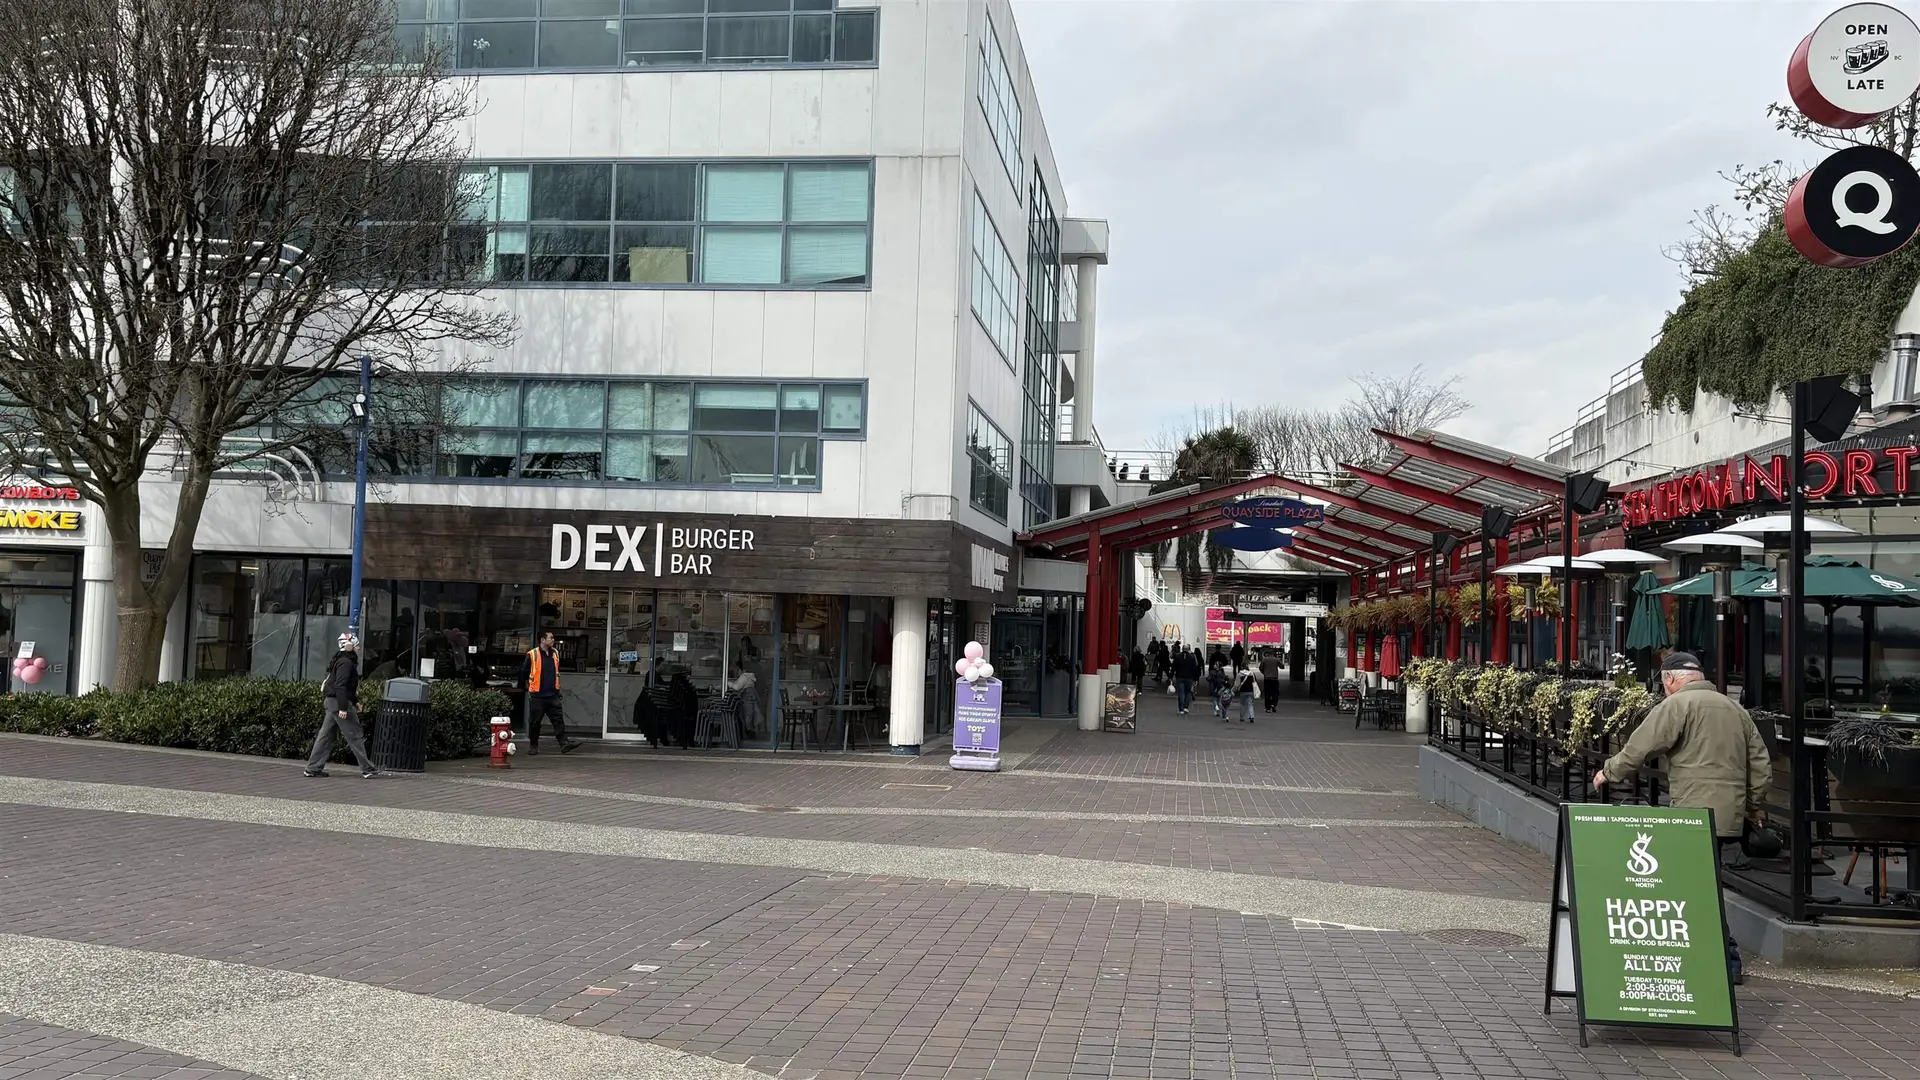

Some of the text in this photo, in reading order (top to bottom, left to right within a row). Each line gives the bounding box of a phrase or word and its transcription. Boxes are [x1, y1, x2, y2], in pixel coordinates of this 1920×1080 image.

[1845, 24, 1888, 36] OPEN
[1847, 79, 1885, 90] LATE
[1831, 170, 1898, 235] Q
[1622, 458, 1744, 529] STRATHCONA
[1222, 506, 1322, 519] QUAYSIDE PLAZA
[671, 527, 754, 550] BURGER
[551, 523, 648, 572] DEX
[670, 553, 712, 575] BAR
[967, 725, 986, 733] TOYS
[1625, 876, 1663, 884] STRATHCONA
[1606, 898, 1686, 918] HAPPY
[1607, 917, 1690, 941] HOUR
[1657, 940, 1690, 948] SPECIALS
[1624, 959, 1682, 973] ALL DAY
[1626, 983, 1685, 993] 2:00-5:00PM
[1620, 990, 1694, 1002] 8:00PM-CLOSE
